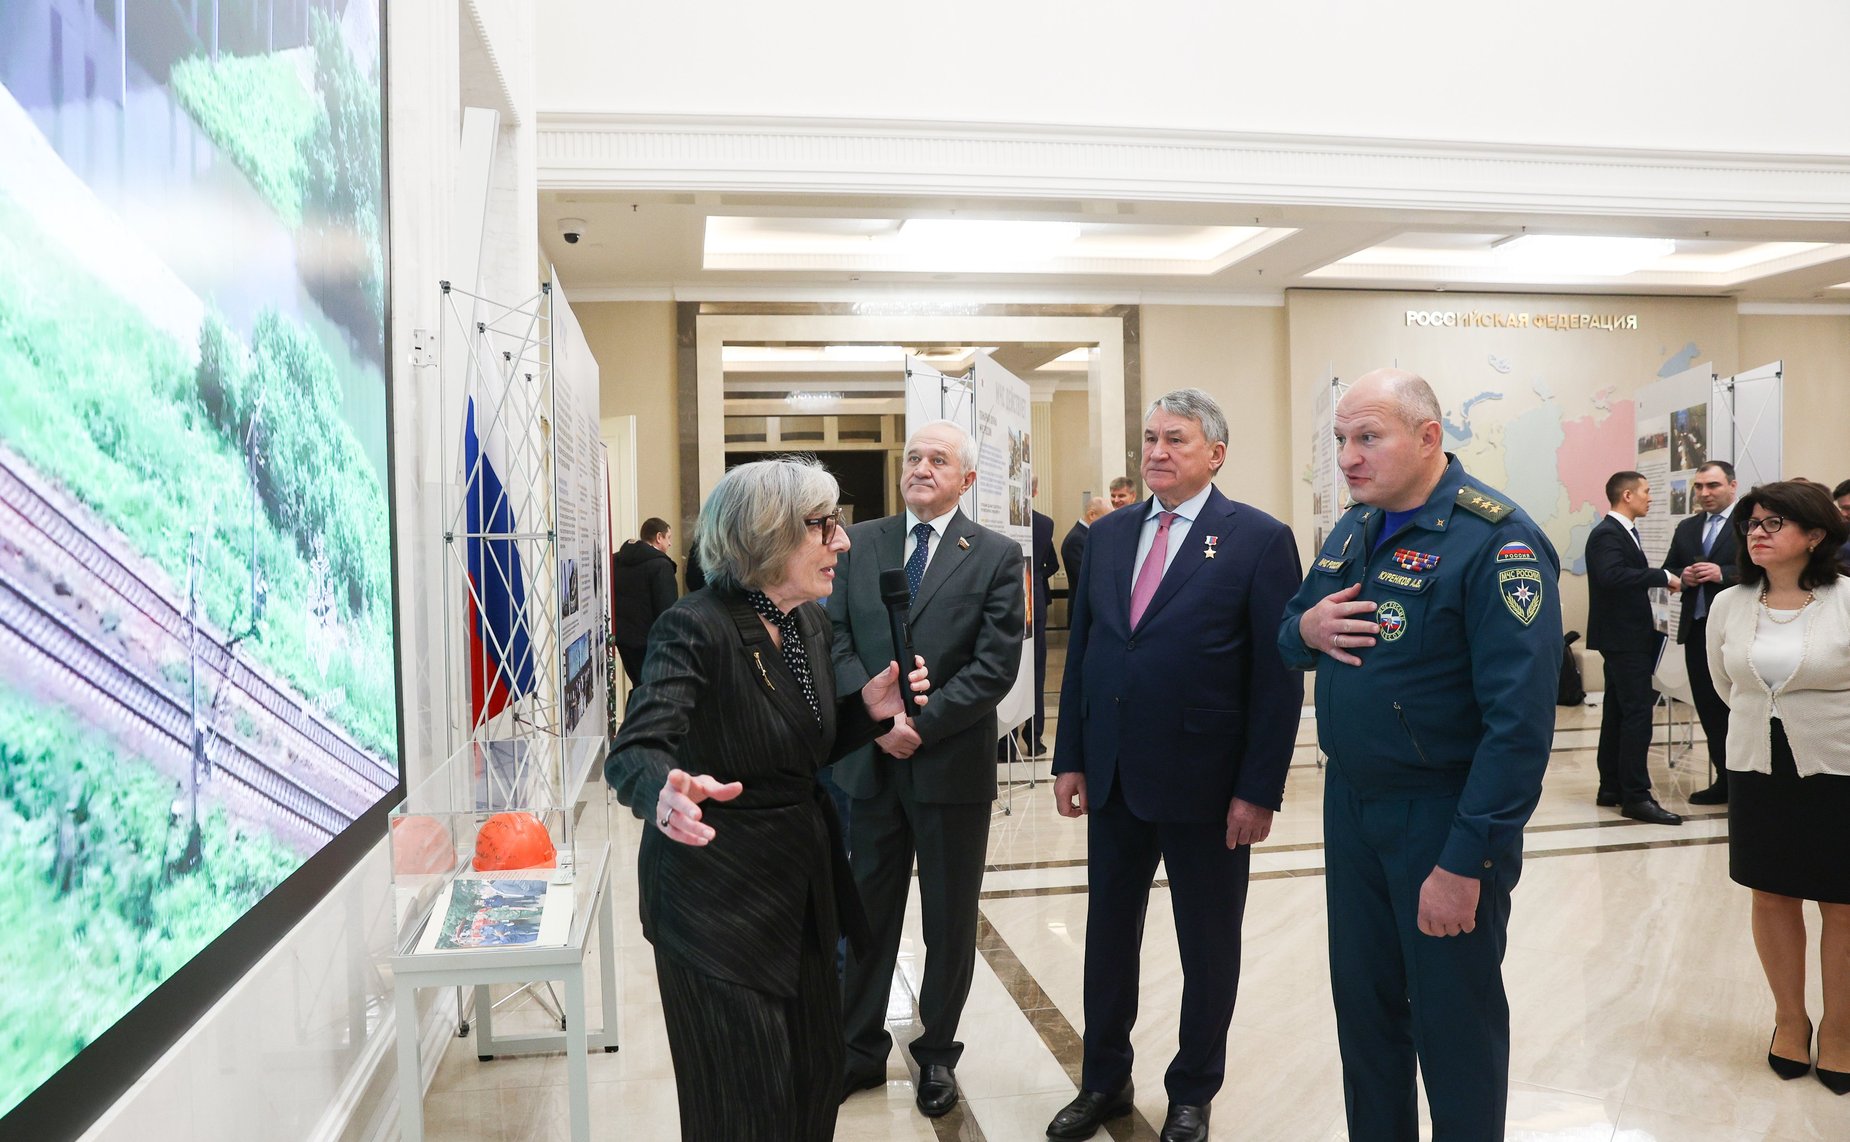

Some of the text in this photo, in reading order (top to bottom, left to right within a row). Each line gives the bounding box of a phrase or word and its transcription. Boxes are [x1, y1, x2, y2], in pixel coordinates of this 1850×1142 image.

[1405, 309, 1638, 331] РОССИЙСКАЯ ФЕДЕРАЦИЯ
[1378, 570, 1412, 586] КУРЕНКОВ
[1501, 569, 1540, 581] МЧС РОССИИ
